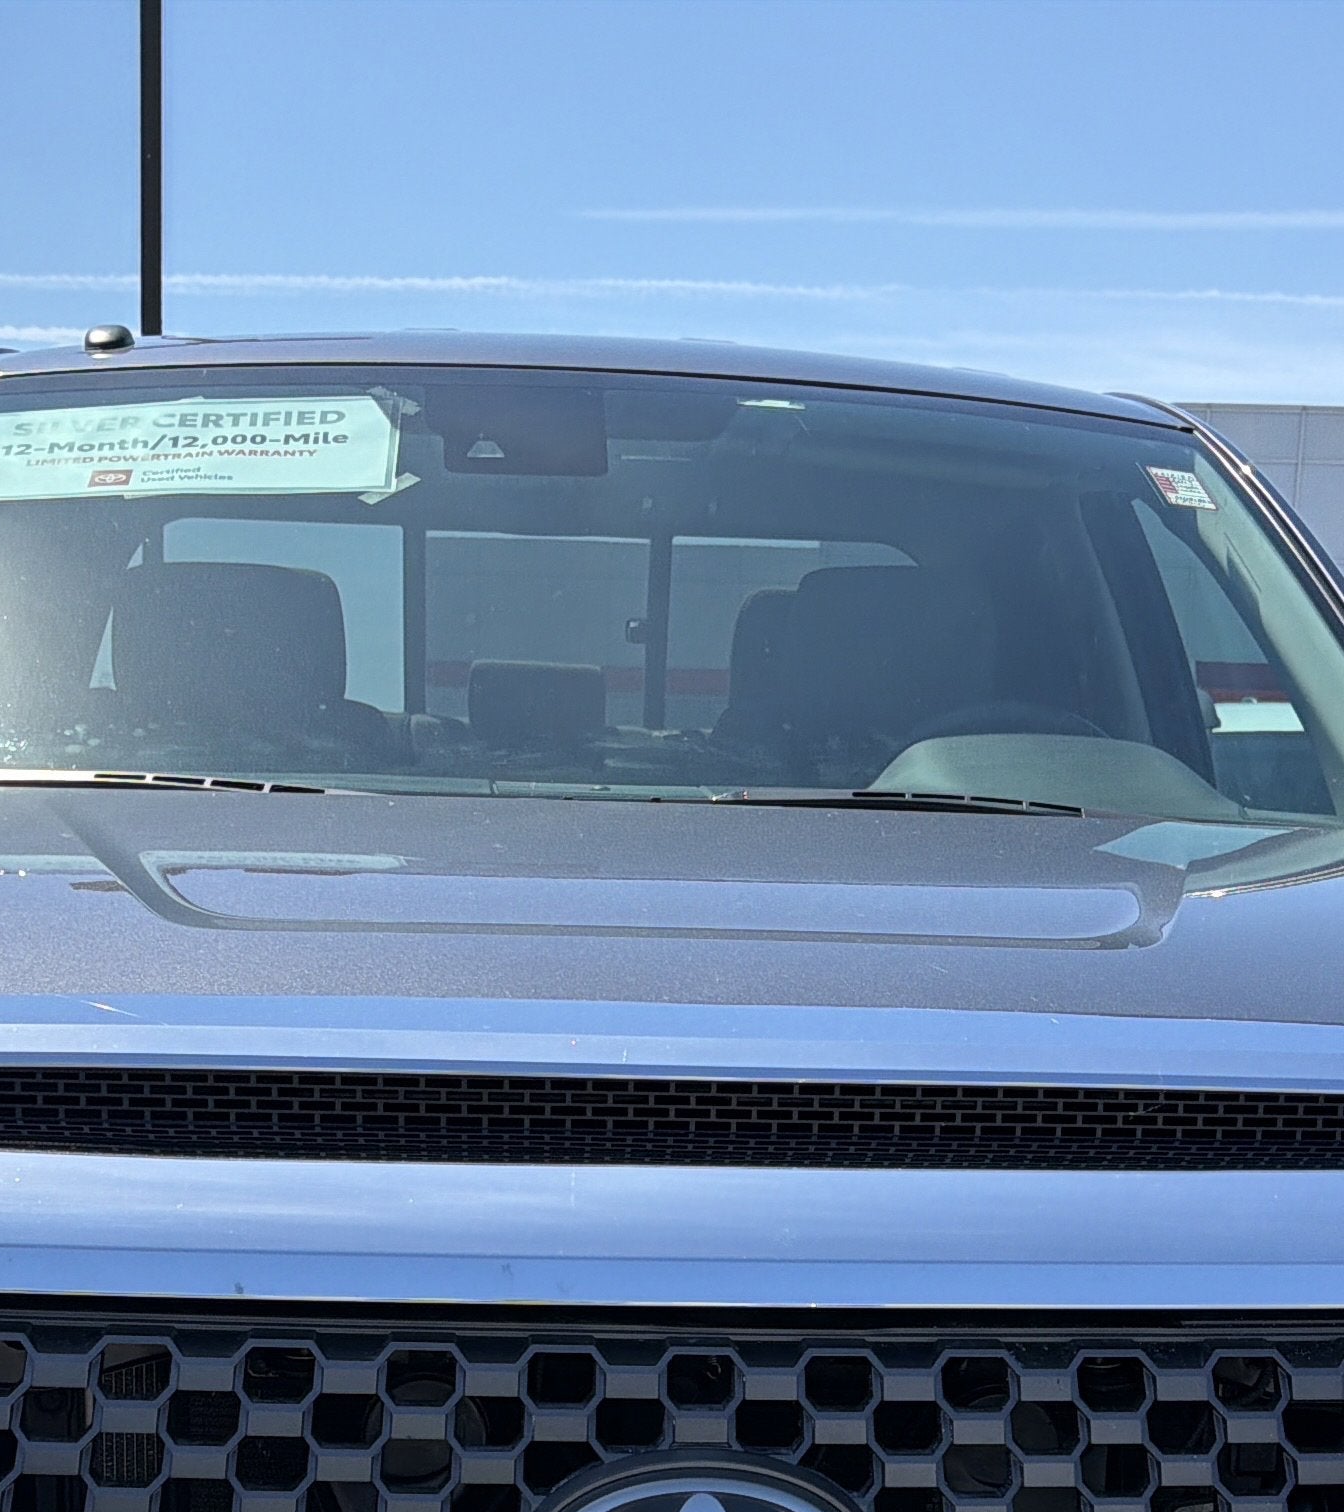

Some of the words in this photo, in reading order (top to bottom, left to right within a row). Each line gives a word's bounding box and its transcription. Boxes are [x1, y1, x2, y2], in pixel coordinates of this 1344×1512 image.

[153, 410, 346, 429] CERTIFIED
[1, 431, 349, 457] 12-Month/12,000-Mile
[26, 456, 94, 467] LIMITED
[98, 450, 213, 463] POWERTRAIN
[217, 448, 317, 457] WARRANTY
[179, 473, 233, 482] Vehicles
